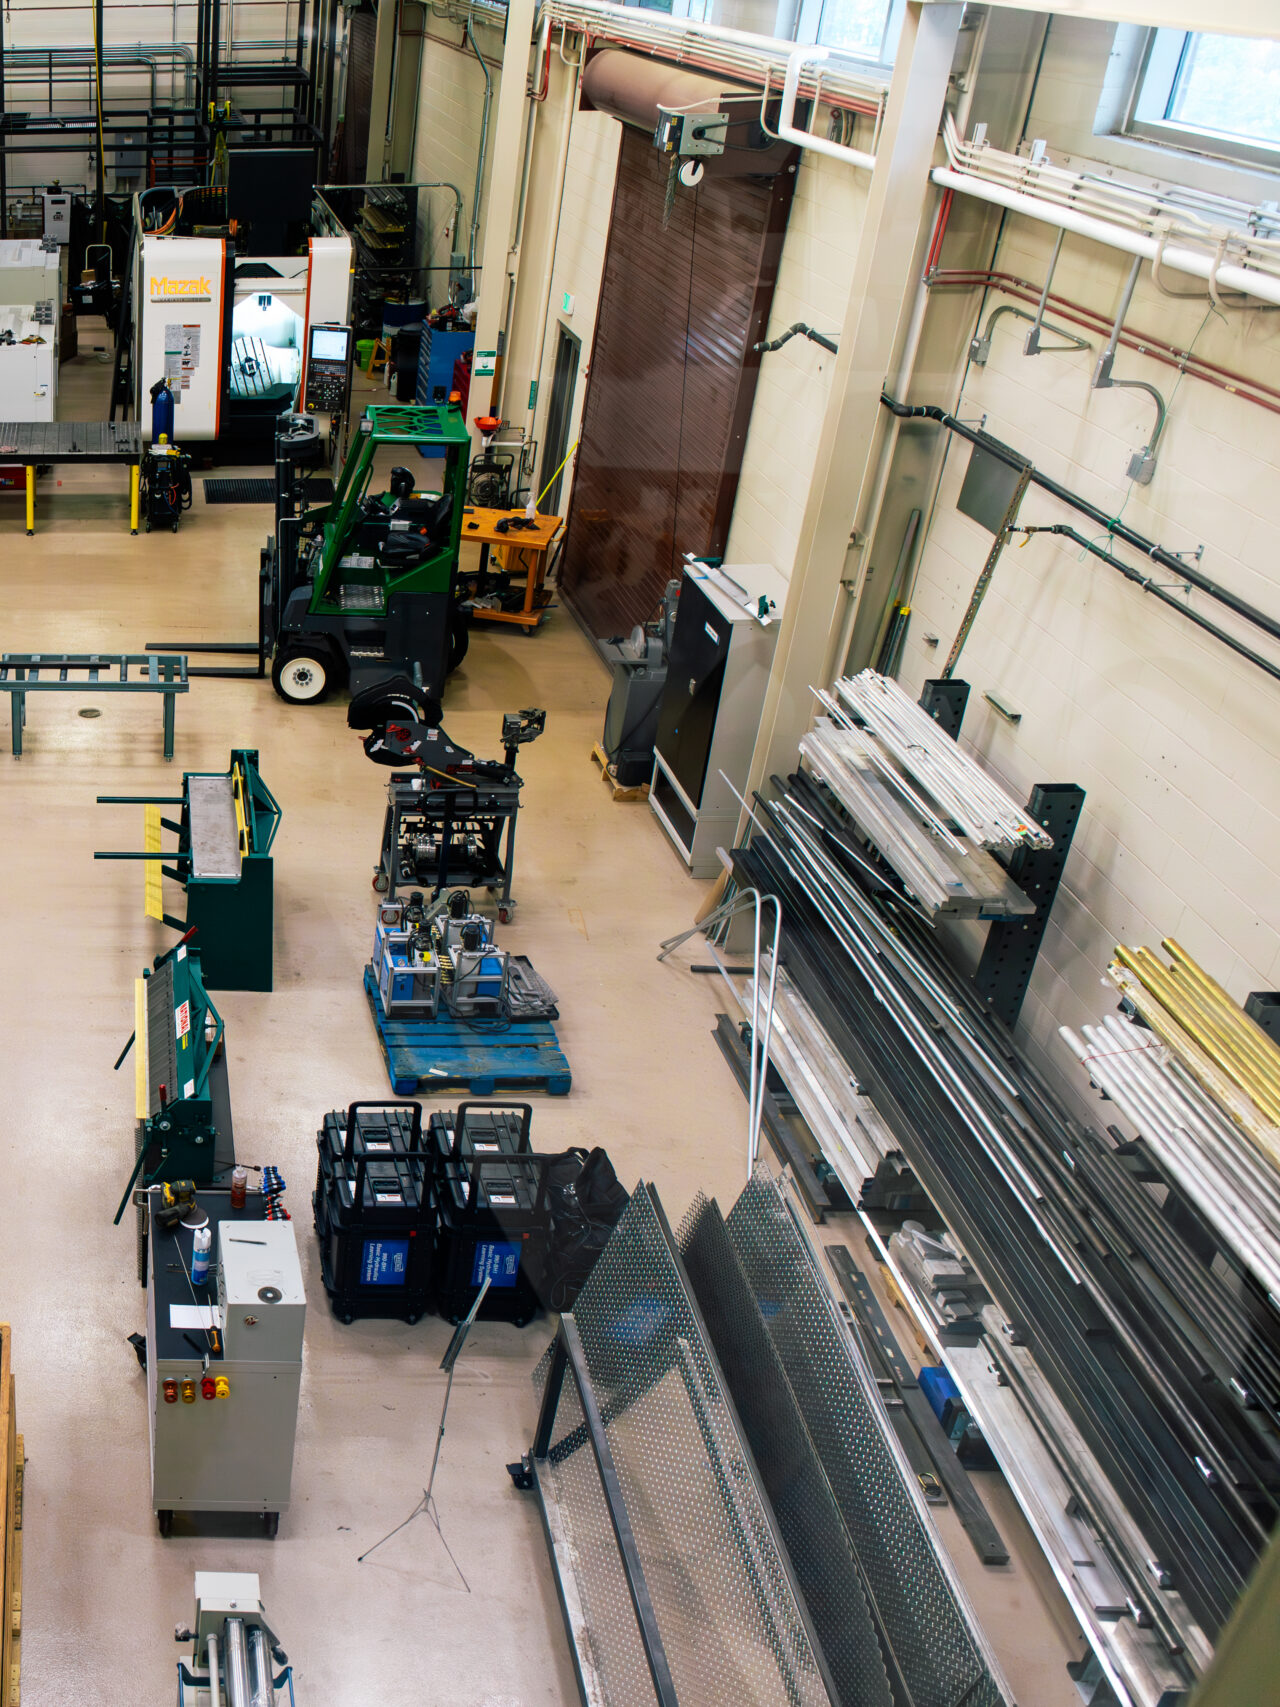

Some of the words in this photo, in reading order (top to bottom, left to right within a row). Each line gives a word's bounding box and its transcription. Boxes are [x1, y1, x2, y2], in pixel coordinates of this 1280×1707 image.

[150, 276, 212, 295] Mazak
[180, 1002, 189, 1034] NATIONAL
[367, 1243, 375, 1264] Learning
[479, 1244, 487, 1265] Learning
[487, 1244, 495, 1258] Basic
[373, 1256, 381, 1281] Hydraulics
[477, 1265, 485, 1283] System
